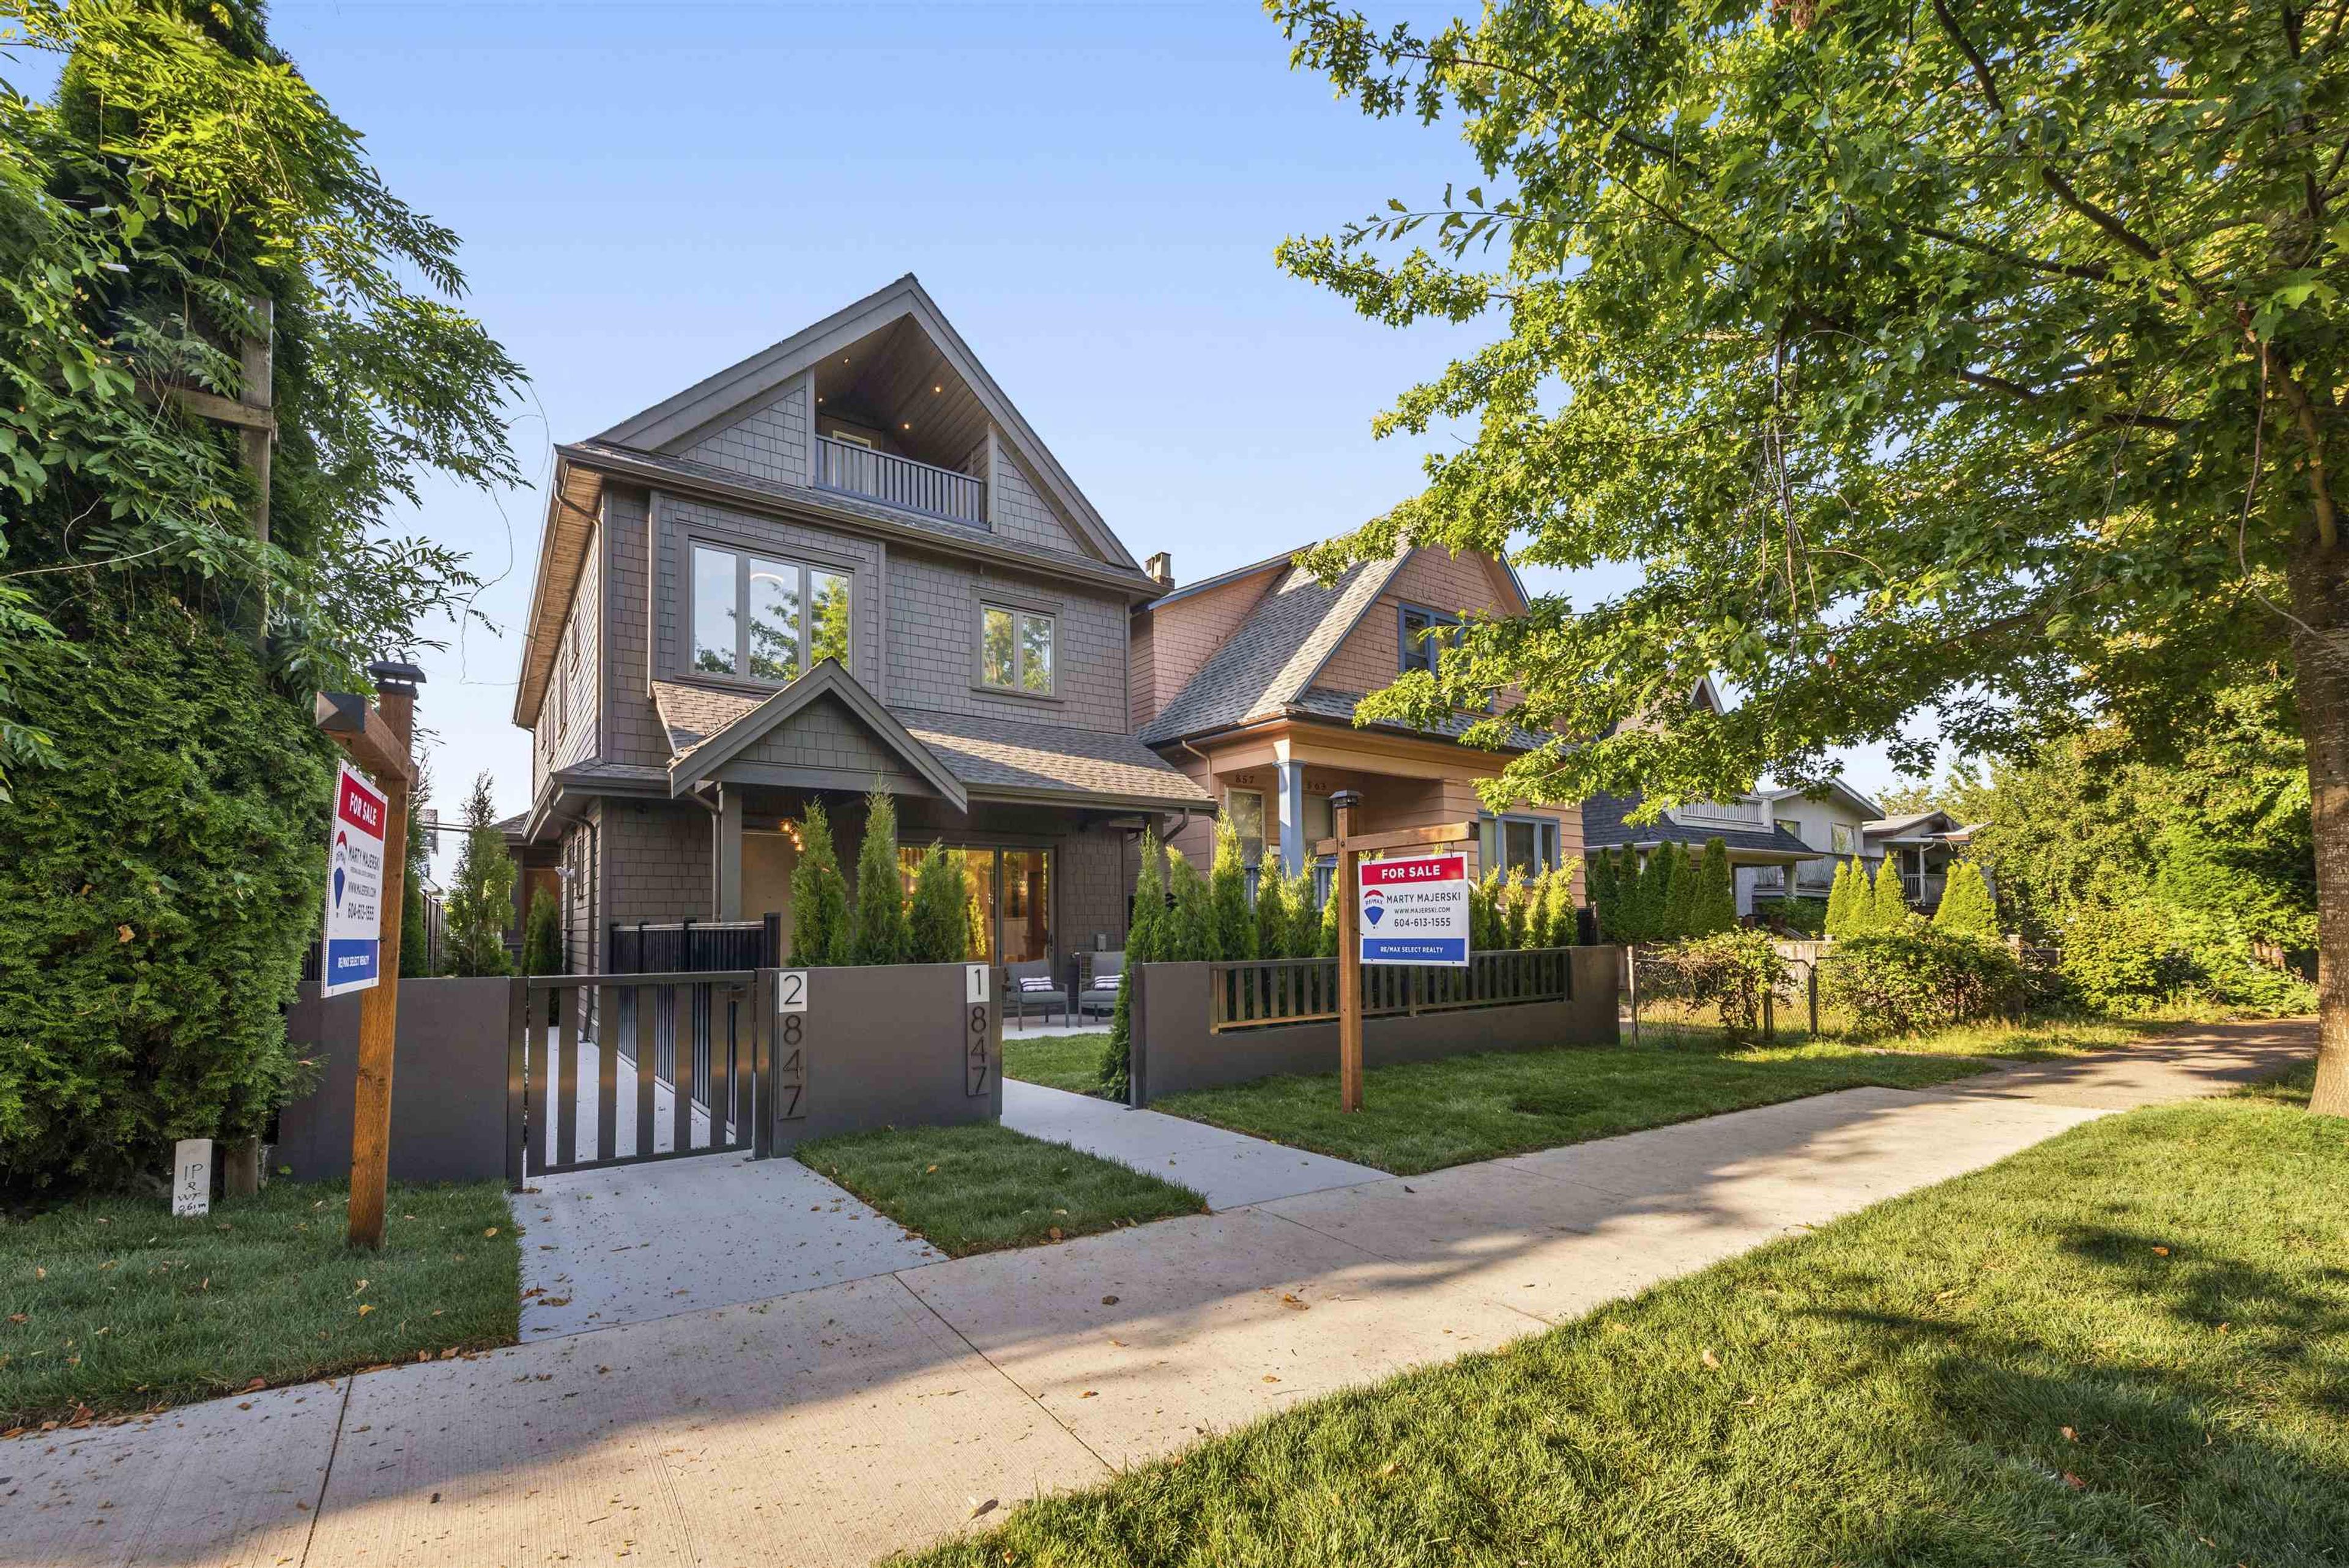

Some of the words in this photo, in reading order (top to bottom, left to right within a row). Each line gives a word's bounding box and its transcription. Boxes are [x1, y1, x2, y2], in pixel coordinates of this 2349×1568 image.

[349, 791, 362, 818] FOR
[362, 801, 377, 827] SALE
[348, 845, 362, 863] MARTY
[362, 851, 380, 871] MAJERSKI
[1381, 868, 1405, 879] FOR
[1409, 864, 1441, 877] SALE
[1386, 894, 1414, 904] MARTY
[1417, 892, 1461, 902] MAJERSKI
[1394, 918, 1450, 927] 604-613-1555
[784, 975, 802, 1005] 2
[974, 968, 981, 995] 1
